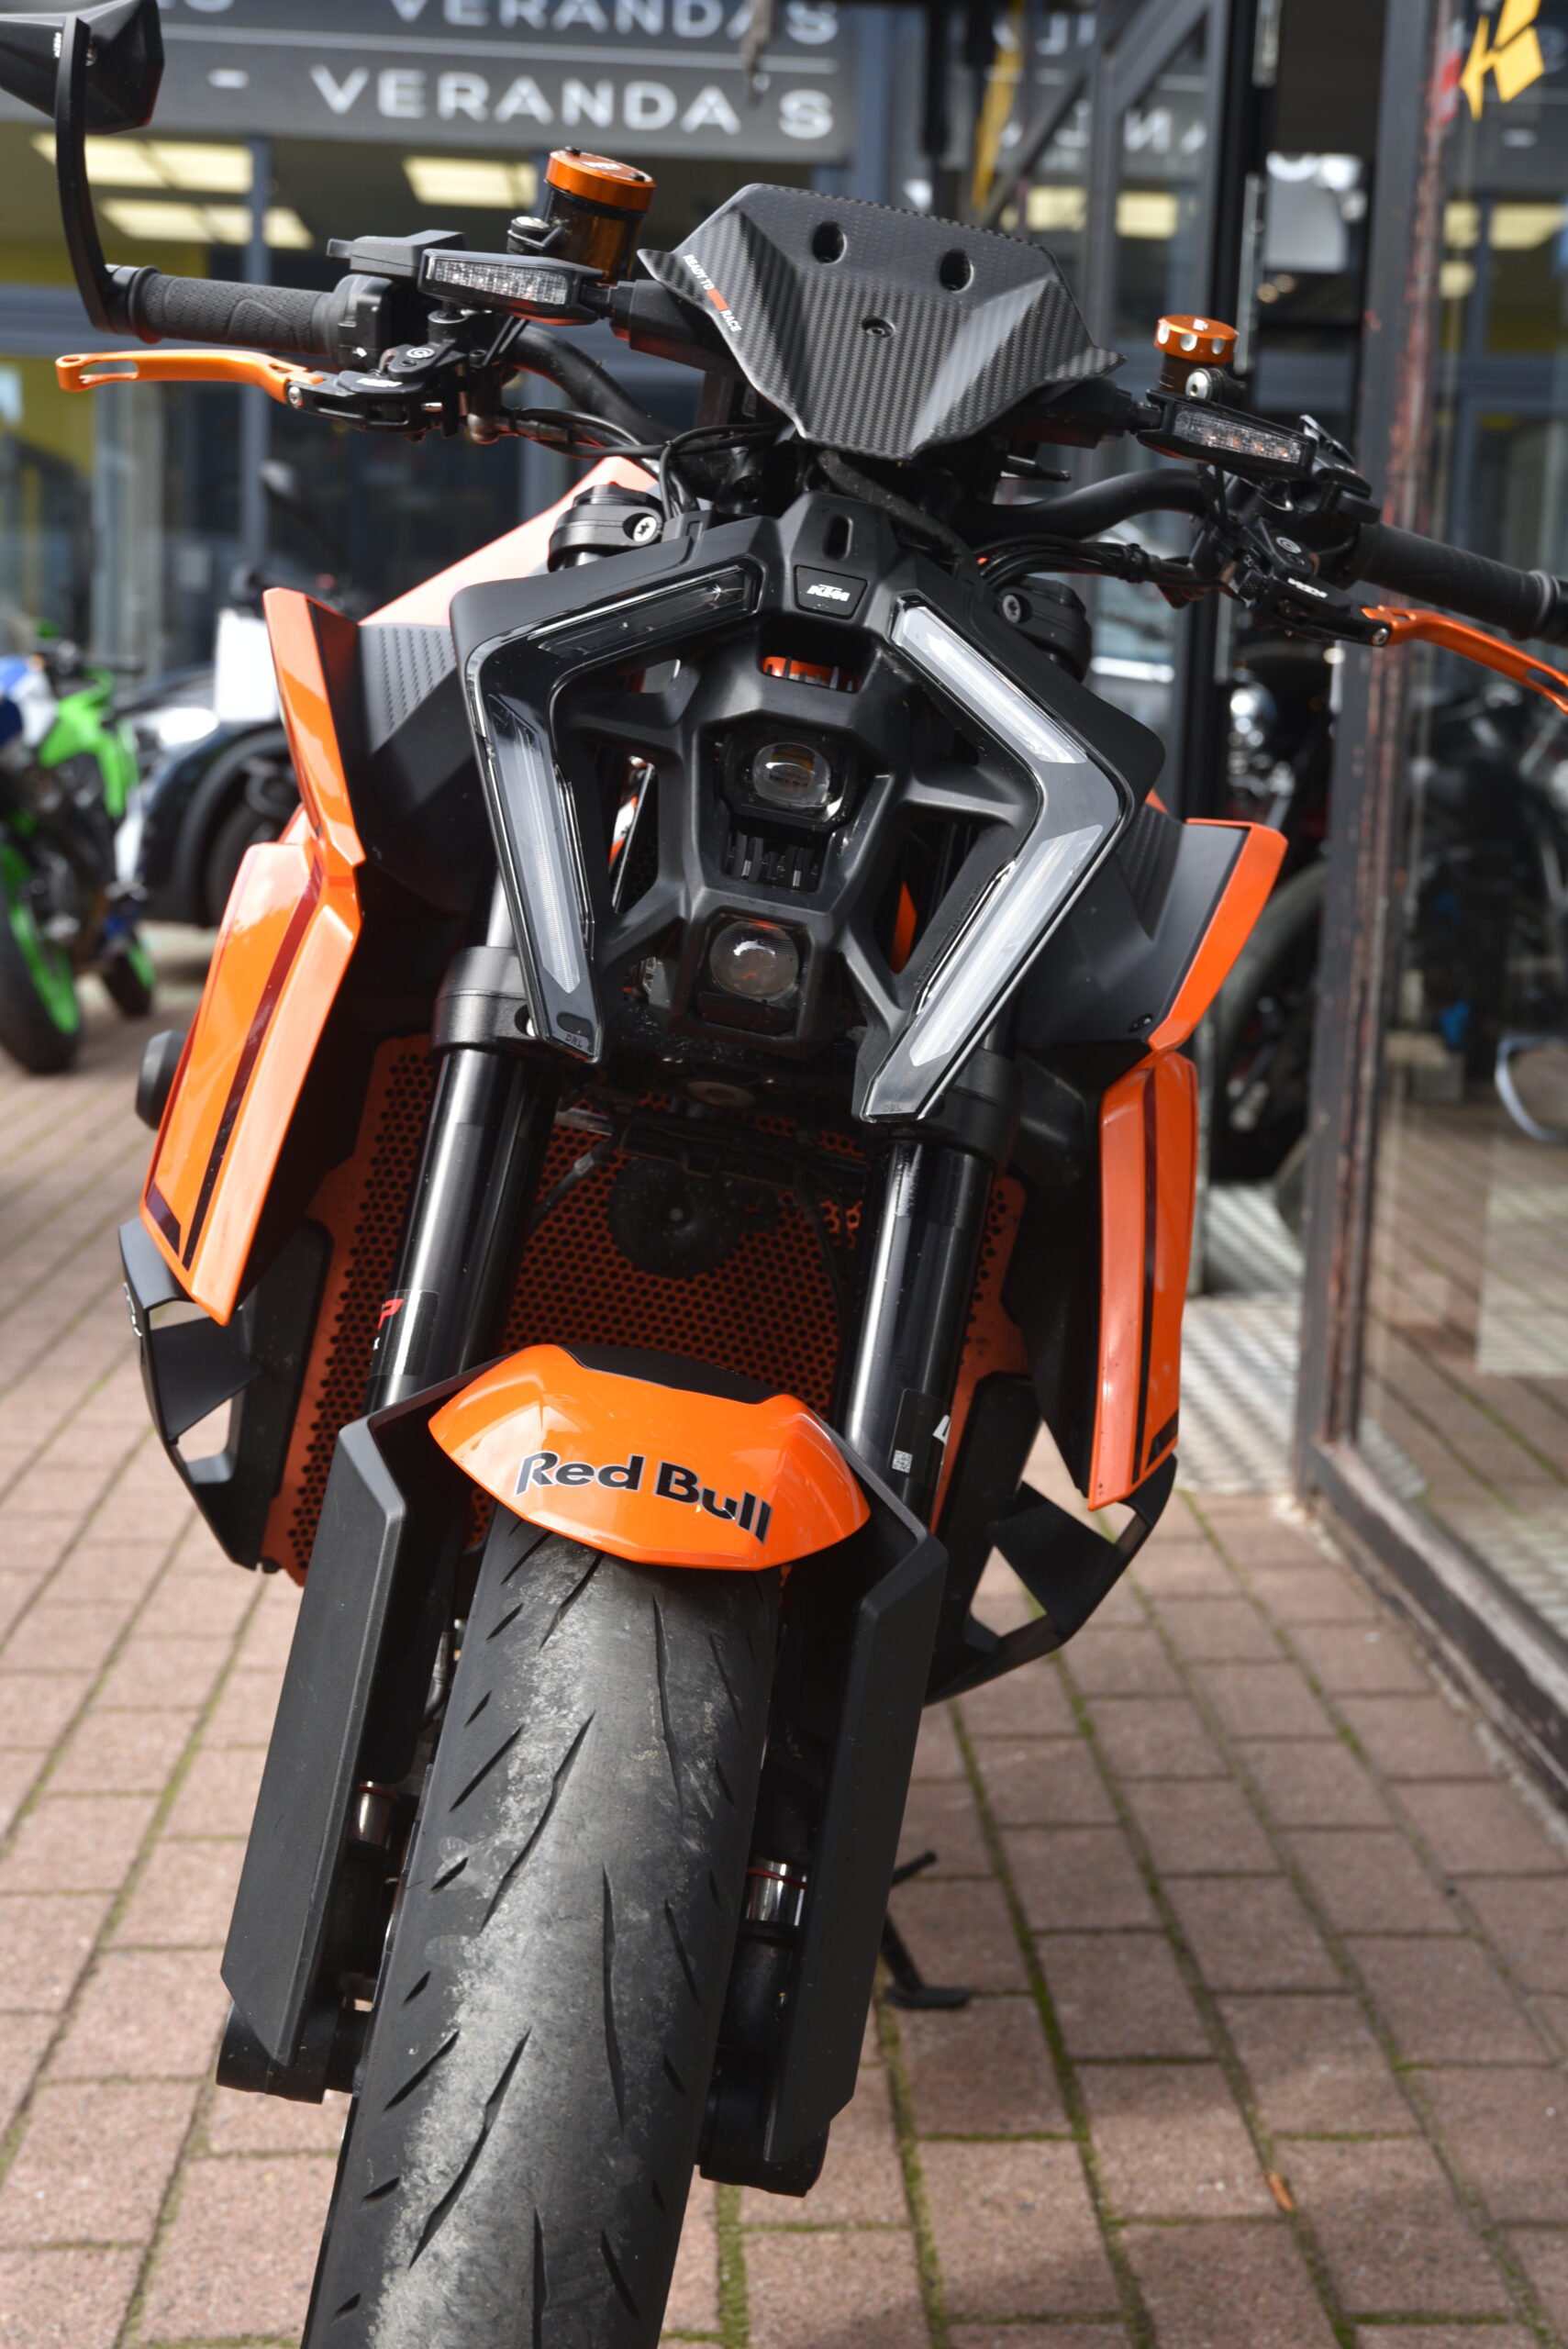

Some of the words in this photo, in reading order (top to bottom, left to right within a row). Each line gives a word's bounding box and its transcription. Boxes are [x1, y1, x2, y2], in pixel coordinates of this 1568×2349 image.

[682, 254, 708, 279] READY
[700, 278, 715, 290] TO
[719, 309, 742, 332] RACE
[806, 584, 851, 602] KTM
[514, 1451, 646, 1497] Red
[654, 1461, 773, 1545] Bull
